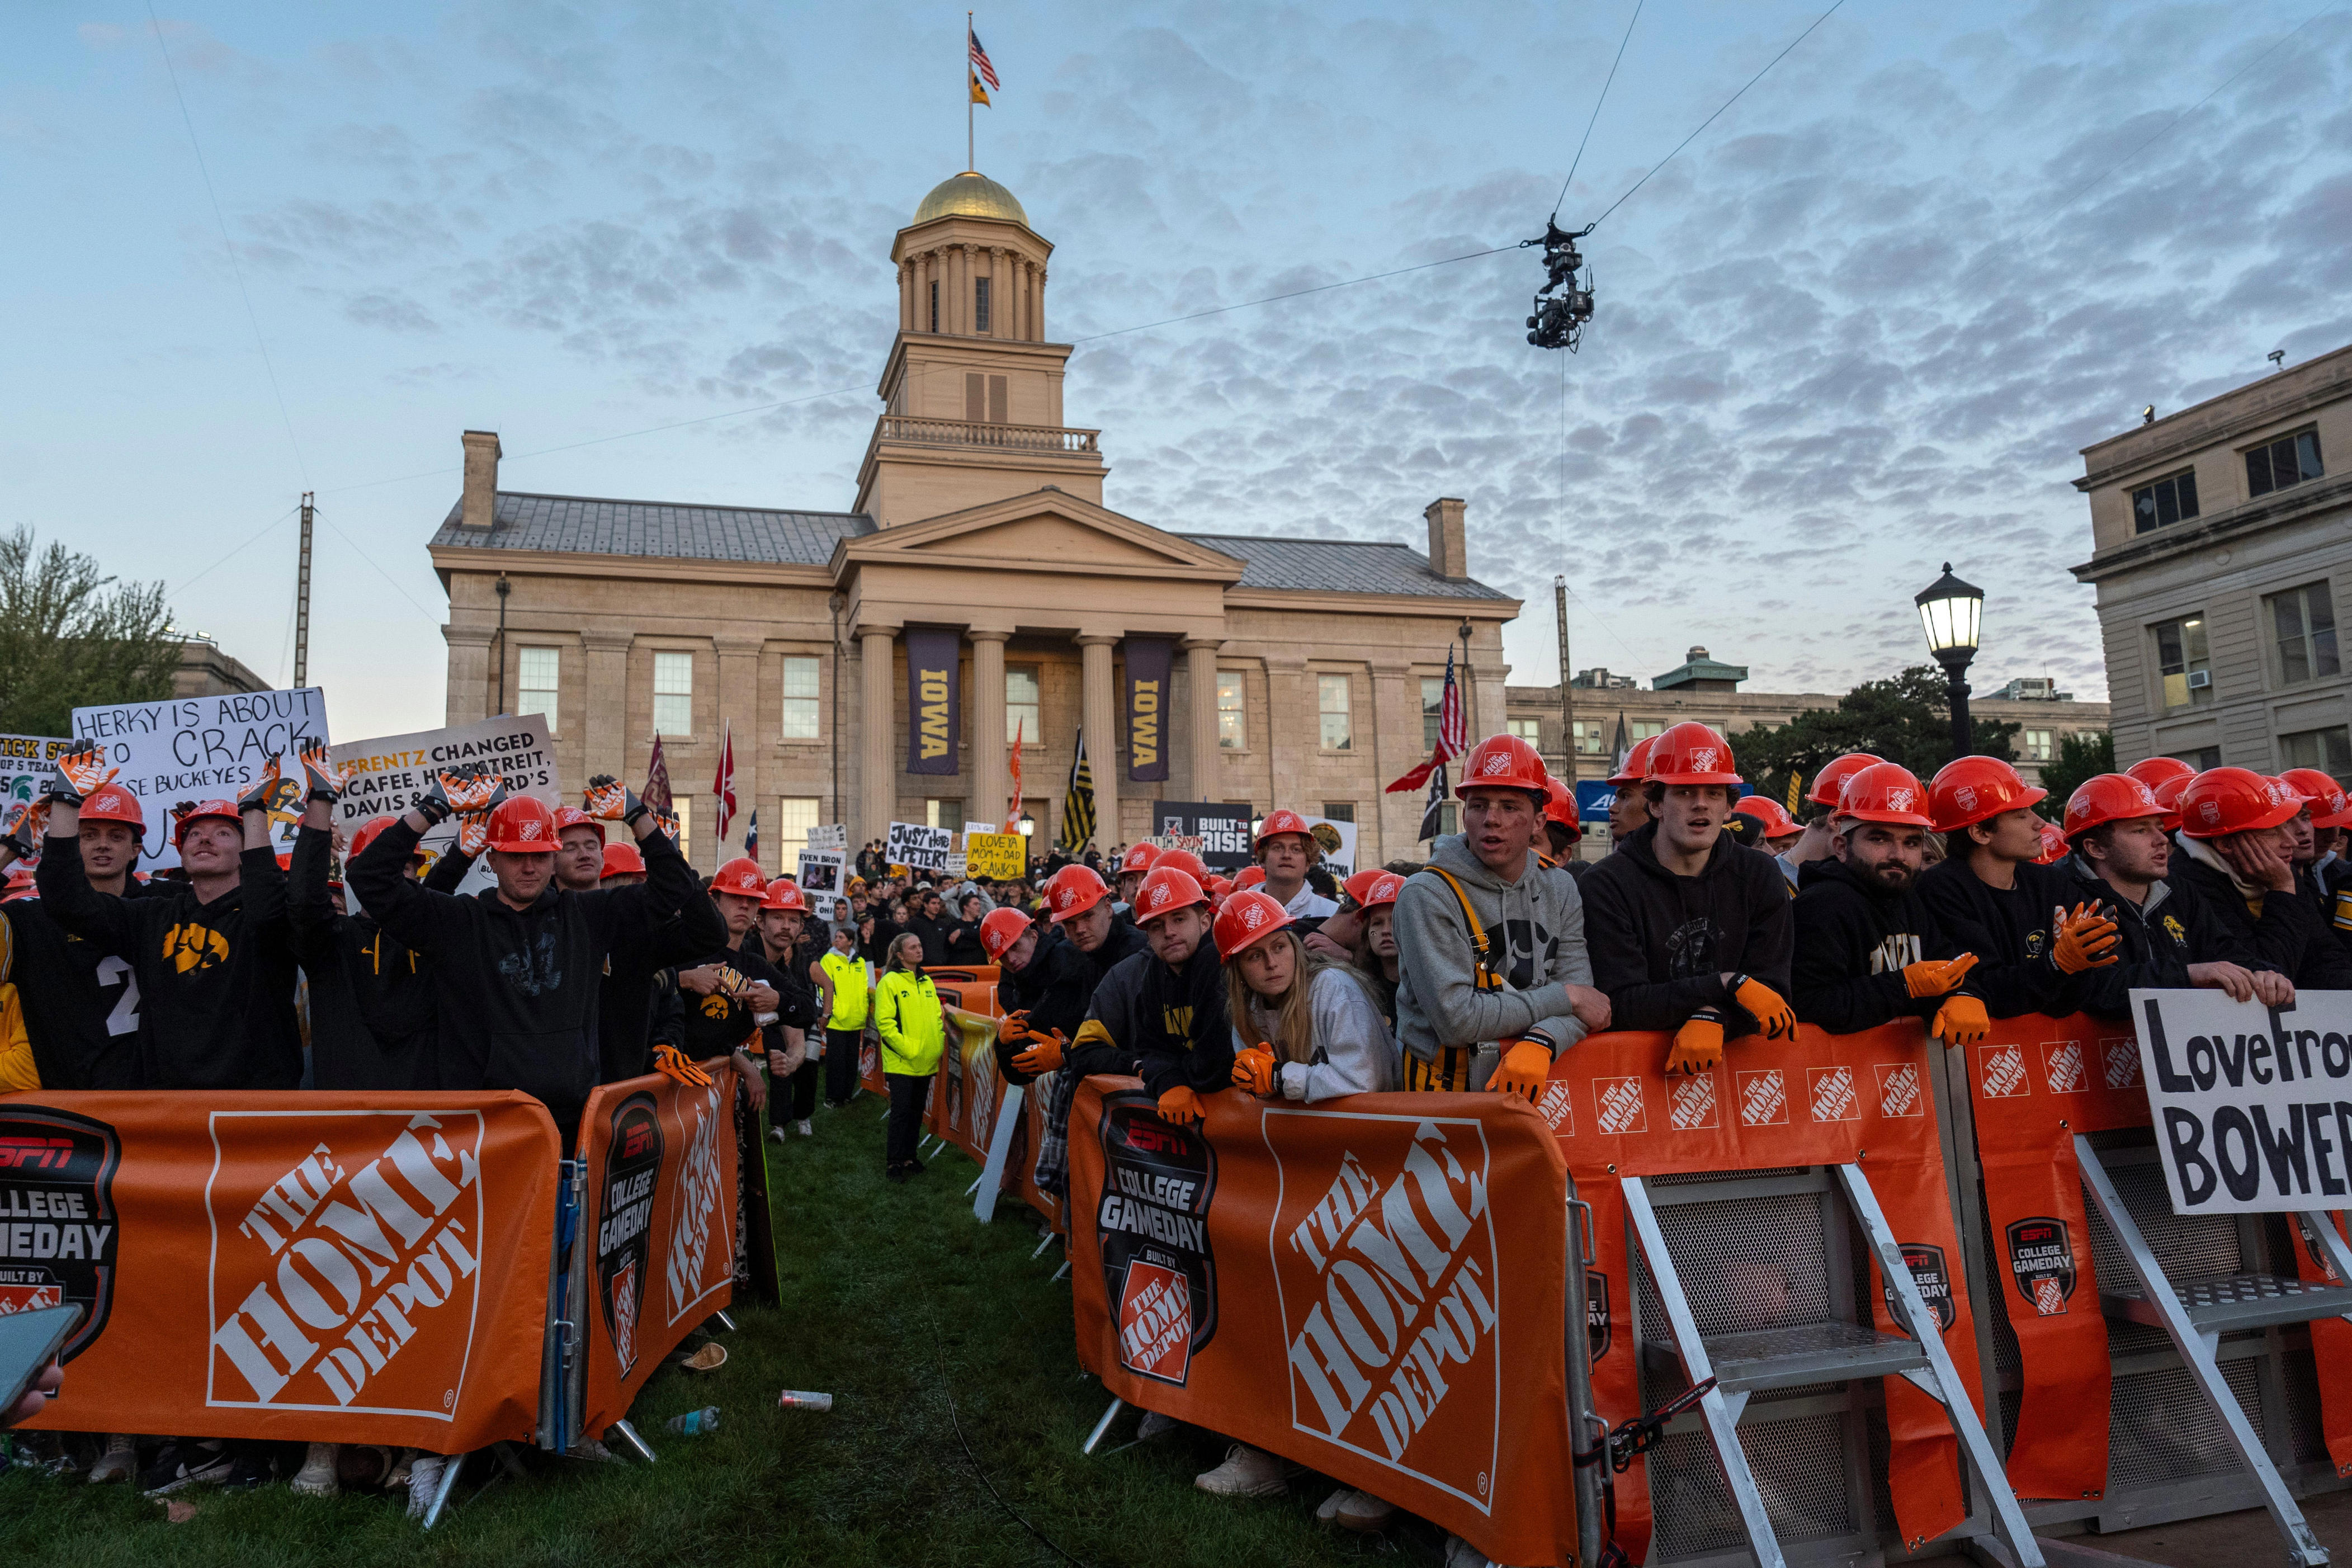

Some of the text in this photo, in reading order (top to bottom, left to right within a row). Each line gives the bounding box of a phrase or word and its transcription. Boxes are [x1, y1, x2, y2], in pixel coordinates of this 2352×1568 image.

[77, 691, 314, 739] HERKY IS ABOUT
[920, 669, 948, 760] IOWA
[1134, 680, 1159, 768] IOWA
[0, 738, 39, 758] ICK
[173, 721, 311, 767] CRACK
[338, 733, 534, 776] FERENTZ CHANGED
[1695, 750, 1704, 760] THE
[0, 759, 14, 770] OP
[1484, 753, 1510, 776] HOME
[1487, 754, 1498, 763] THE
[1493, 762, 1511, 776] DEPOT
[1692, 748, 1716, 772] HOME
[1703, 757, 1717, 772] DEPOT
[0, 776, 11, 793] 5
[156, 765, 251, 791] BUCKEYES
[96, 795, 120, 811] HOME
[343, 794, 405, 819] DAVIS
[410, 791, 422, 808] &
[1590, 793, 1617, 807] AC
[1888, 788, 1912, 810] HOME
[1891, 790, 1901, 799] THE
[1898, 797, 1913, 811] DEPOT
[520, 820, 542, 841] HOME
[891, 825, 931, 847] JUST
[1199, 818, 1248, 832] BUILT TO
[971, 848, 993, 859] MOM
[1004, 850, 1021, 860] DAD
[980, 835, 1018, 848] LOVE YA
[1200, 831, 1248, 853] RISE
[799, 853, 841, 865] EVEN BRON
[899, 845, 948, 870] PETER!
[741, 873, 757, 889] HOME
[1151, 883, 1167, 908] HOME
[1247, 903, 1260, 929] HOME
[96, 955, 141, 1037] 2
[2106, 1043, 2121, 1062] THE
[2267, 1000, 2352, 1082] Fro
[1983, 1045, 2022, 1097] HOME
[1985, 1051, 2004, 1073] THE
[2047, 1047, 2063, 1068] THE
[2048, 1041, 2081, 1093] HOME
[2105, 1036, 2139, 1088] HOME
[1743, 1076, 1761, 1099] THE
[1813, 1073, 1831, 1095] THE
[1883, 1069, 1900, 1090] THE
[2001, 1062, 2026, 1096] DEPOT
[2063, 1059, 2084, 1092] DEPOT
[1537, 1080, 1568, 1120] OME
[1600, 1083, 1619, 1106] THE
[1671, 1080, 1691, 1102] THE
[1671, 1073, 1713, 1128] HOME
[1741, 1069, 1783, 1125] HOME
[1812, 1066, 1853, 1121] HOME
[1830, 1085, 1855, 1120] DEPOT
[1881, 1063, 1918, 1117] HOME
[1895, 1082, 1920, 1116] DEPOT
[1598, 1076, 1641, 1133] HOME
[1617, 1097, 1643, 1132] DEPOT
[1690, 1093, 1715, 1128] DEPOT
[1760, 1089, 1786, 1124] DEPOT
[622, 1122, 654, 1159] ESPN
[1125, 1118, 1187, 1156] ESPN
[0, 1137, 74, 1168] SPN
[239, 1142, 346, 1255] THE
[611, 1168, 654, 1213] COLLEGE
[1117, 1166, 1196, 1212] COLLEGE
[0, 1189, 88, 1219] LEGE
[1288, 1149, 1381, 1274] THE
[599, 1196, 654, 1258] GAMEDAY
[1100, 1194, 1205, 1254] GAMEDAY
[2020, 1227, 2052, 1241] ESPN
[0, 1222, 112, 1260] EDAY
[2018, 1245, 2061, 1259] COLLEGE
[213, 1113, 478, 1404] HOME
[1146, 1249, 1175, 1268] BUILT BY
[2013, 1255, 2070, 1273] GAMEDAY
[0, 1271, 45, 1283] UILT BY
[1288, 1121, 1487, 1440] HOME
[1911, 1273, 1939, 1284] LEGE
[2037, 1282, 2047, 1297] THE
[1129, 1277, 1163, 1315] THE
[2038, 1278, 2059, 1314] HOME
[2048, 1290, 2062, 1313] DEPOT
[314, 1219, 479, 1408] DEPOT
[1120, 1273, 1190, 1364] HOME
[1140, 1312, 1191, 1372] DEPOT
[1368, 1256, 1496, 1465] DEPOT
